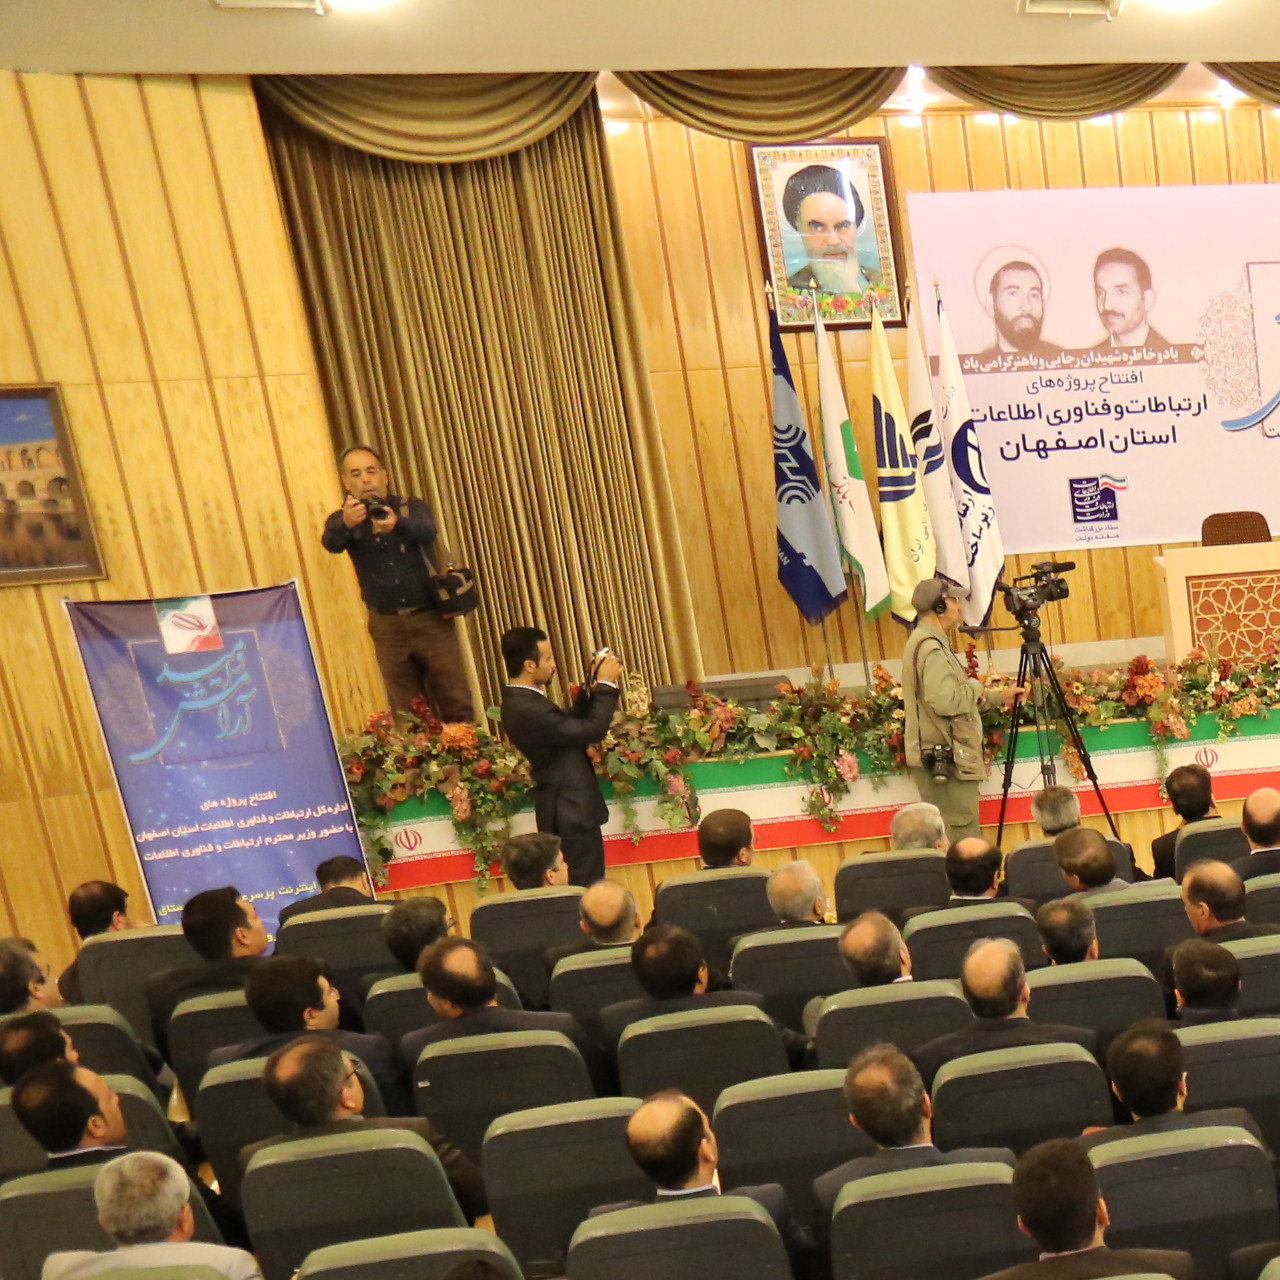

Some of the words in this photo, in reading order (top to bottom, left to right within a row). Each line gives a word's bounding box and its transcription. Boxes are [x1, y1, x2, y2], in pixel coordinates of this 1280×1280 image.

[1012, 353, 1039, 371] باهنر
[1045, 352, 1080, 368] رجایی
[1081, 350, 1122, 367] شهیدان
[1123, 348, 1156, 365] خاطره
[1157, 353, 1163, 364] و
[1163, 347, 1179, 361] یاد
[963, 356, 979, 372] باد
[980, 354, 1014, 372] گرامی
[1099, 371, 1143, 394] افتتاح
[971, 402, 1042, 423] اطلاعات
[1046, 398, 1112, 426] فناوری
[1113, 403, 1124, 421] و
[1125, 394, 1208, 417] ارتباطات
[999, 428, 1106, 462] اصفهان
[1109, 425, 1177, 454] استان
[249, 790, 278, 807] افتتاح
[274, 808, 312, 821] ارتباطات
[171, 824, 200, 838] استان
[200, 818, 234, 831] اطلاعات
[318, 825, 344, 838] حضور
[223, 836, 263, 849] ارتباطات
[264, 833, 295, 846] محترم
[143, 848, 180, 861] اطلاعات
[278, 881, 318, 896] اینترنت
